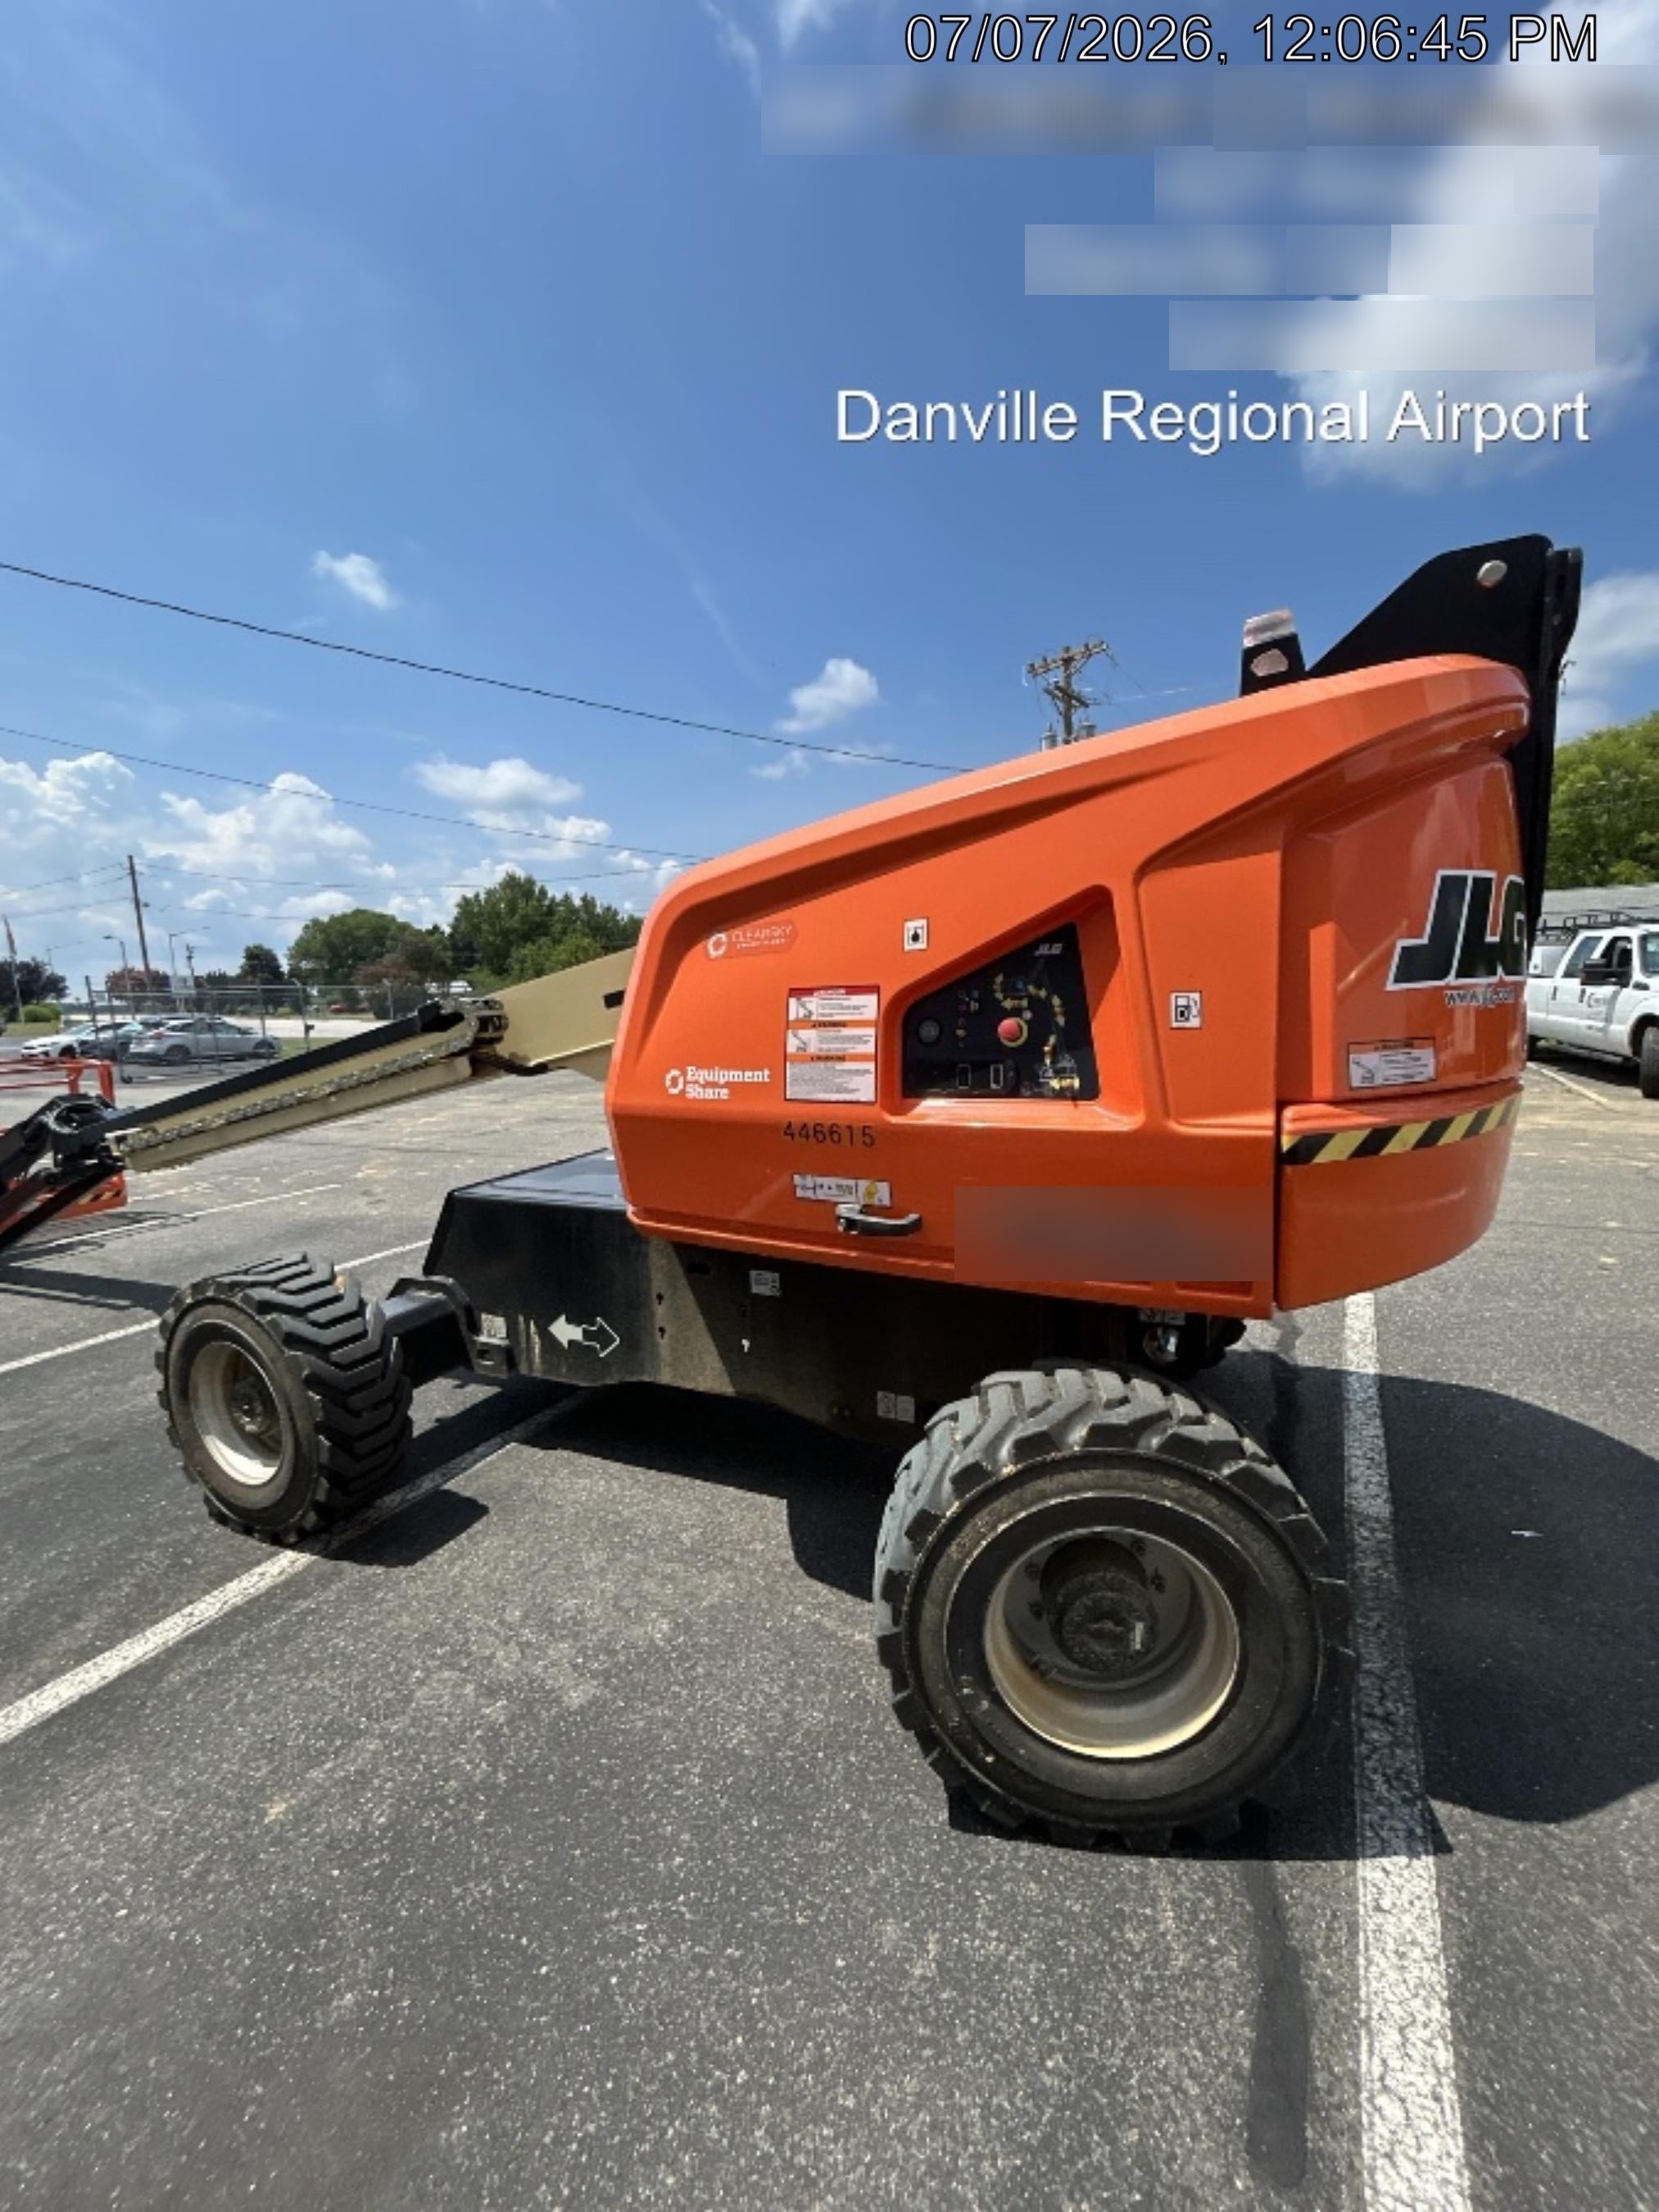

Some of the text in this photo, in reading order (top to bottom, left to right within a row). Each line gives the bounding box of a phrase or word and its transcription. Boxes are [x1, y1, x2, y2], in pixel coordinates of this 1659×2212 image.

[686, 1066, 770, 1085] Equipment
[685, 1083, 729, 1099] Share
[783, 1120, 875, 1148] 446615
